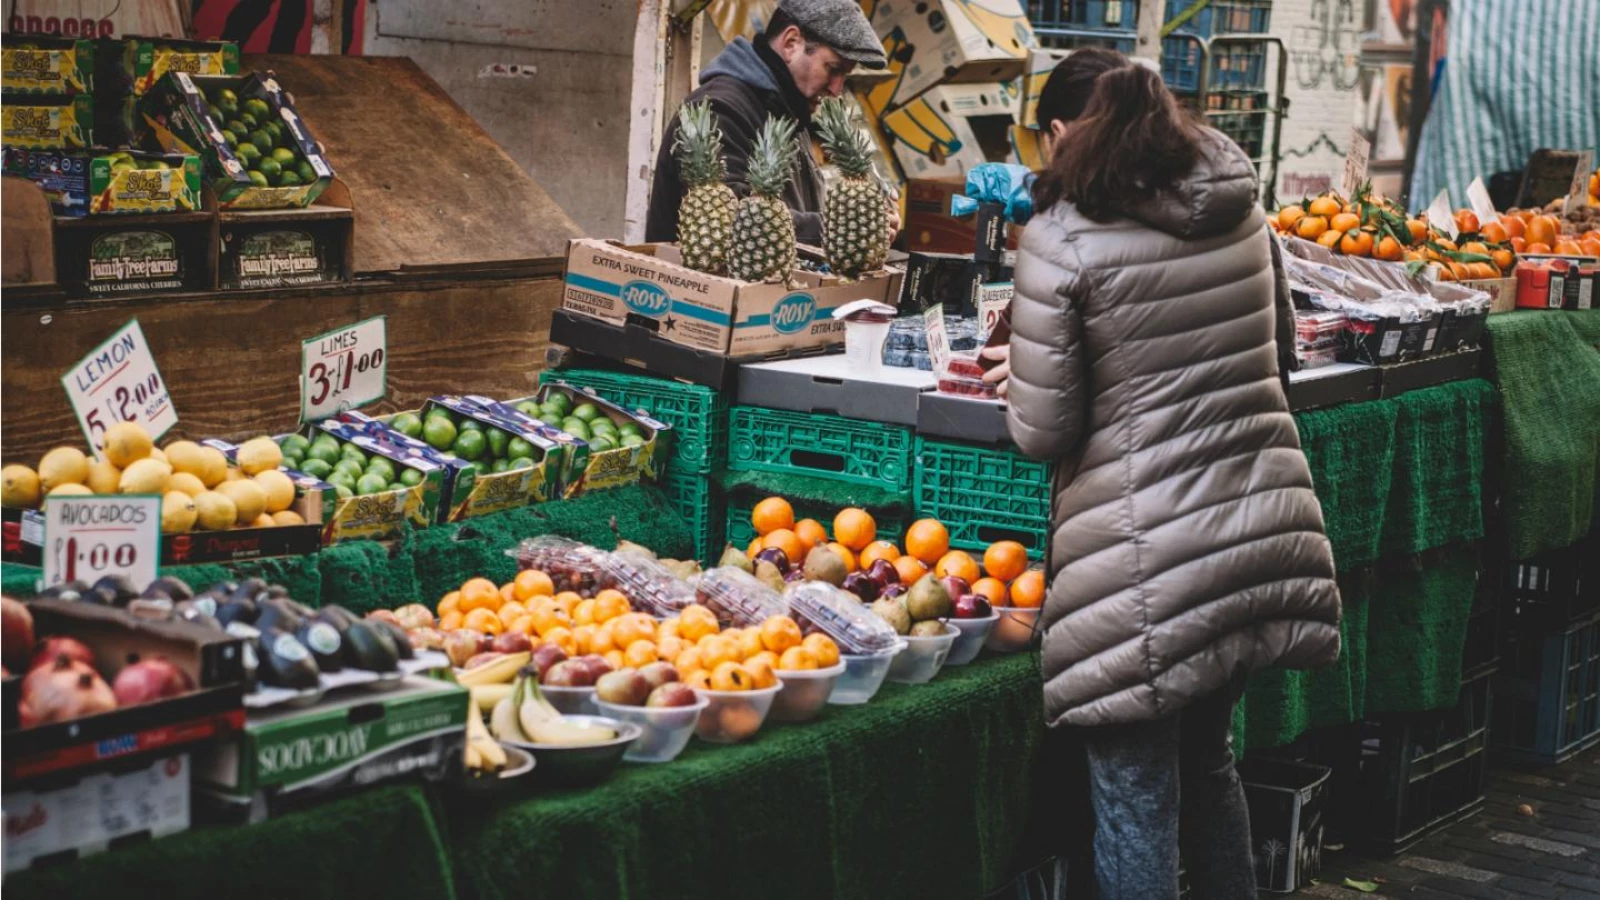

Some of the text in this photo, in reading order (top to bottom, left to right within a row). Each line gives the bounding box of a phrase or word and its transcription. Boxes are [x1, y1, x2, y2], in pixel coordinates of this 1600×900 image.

[592, 255, 710, 294] EXTRA SWEET PINEAPPLE
[627, 286, 664, 310] ROSY
[776, 302, 811, 325] ROSY
[811, 322, 831, 335] EXTRA
[321, 330, 358, 356] LIMES
[76, 333, 136, 392] LEMON
[60, 503, 147, 526] AVOCADOS
[53, 537, 137, 585] £1.00
[258, 725, 371, 776] AVOCADOS
